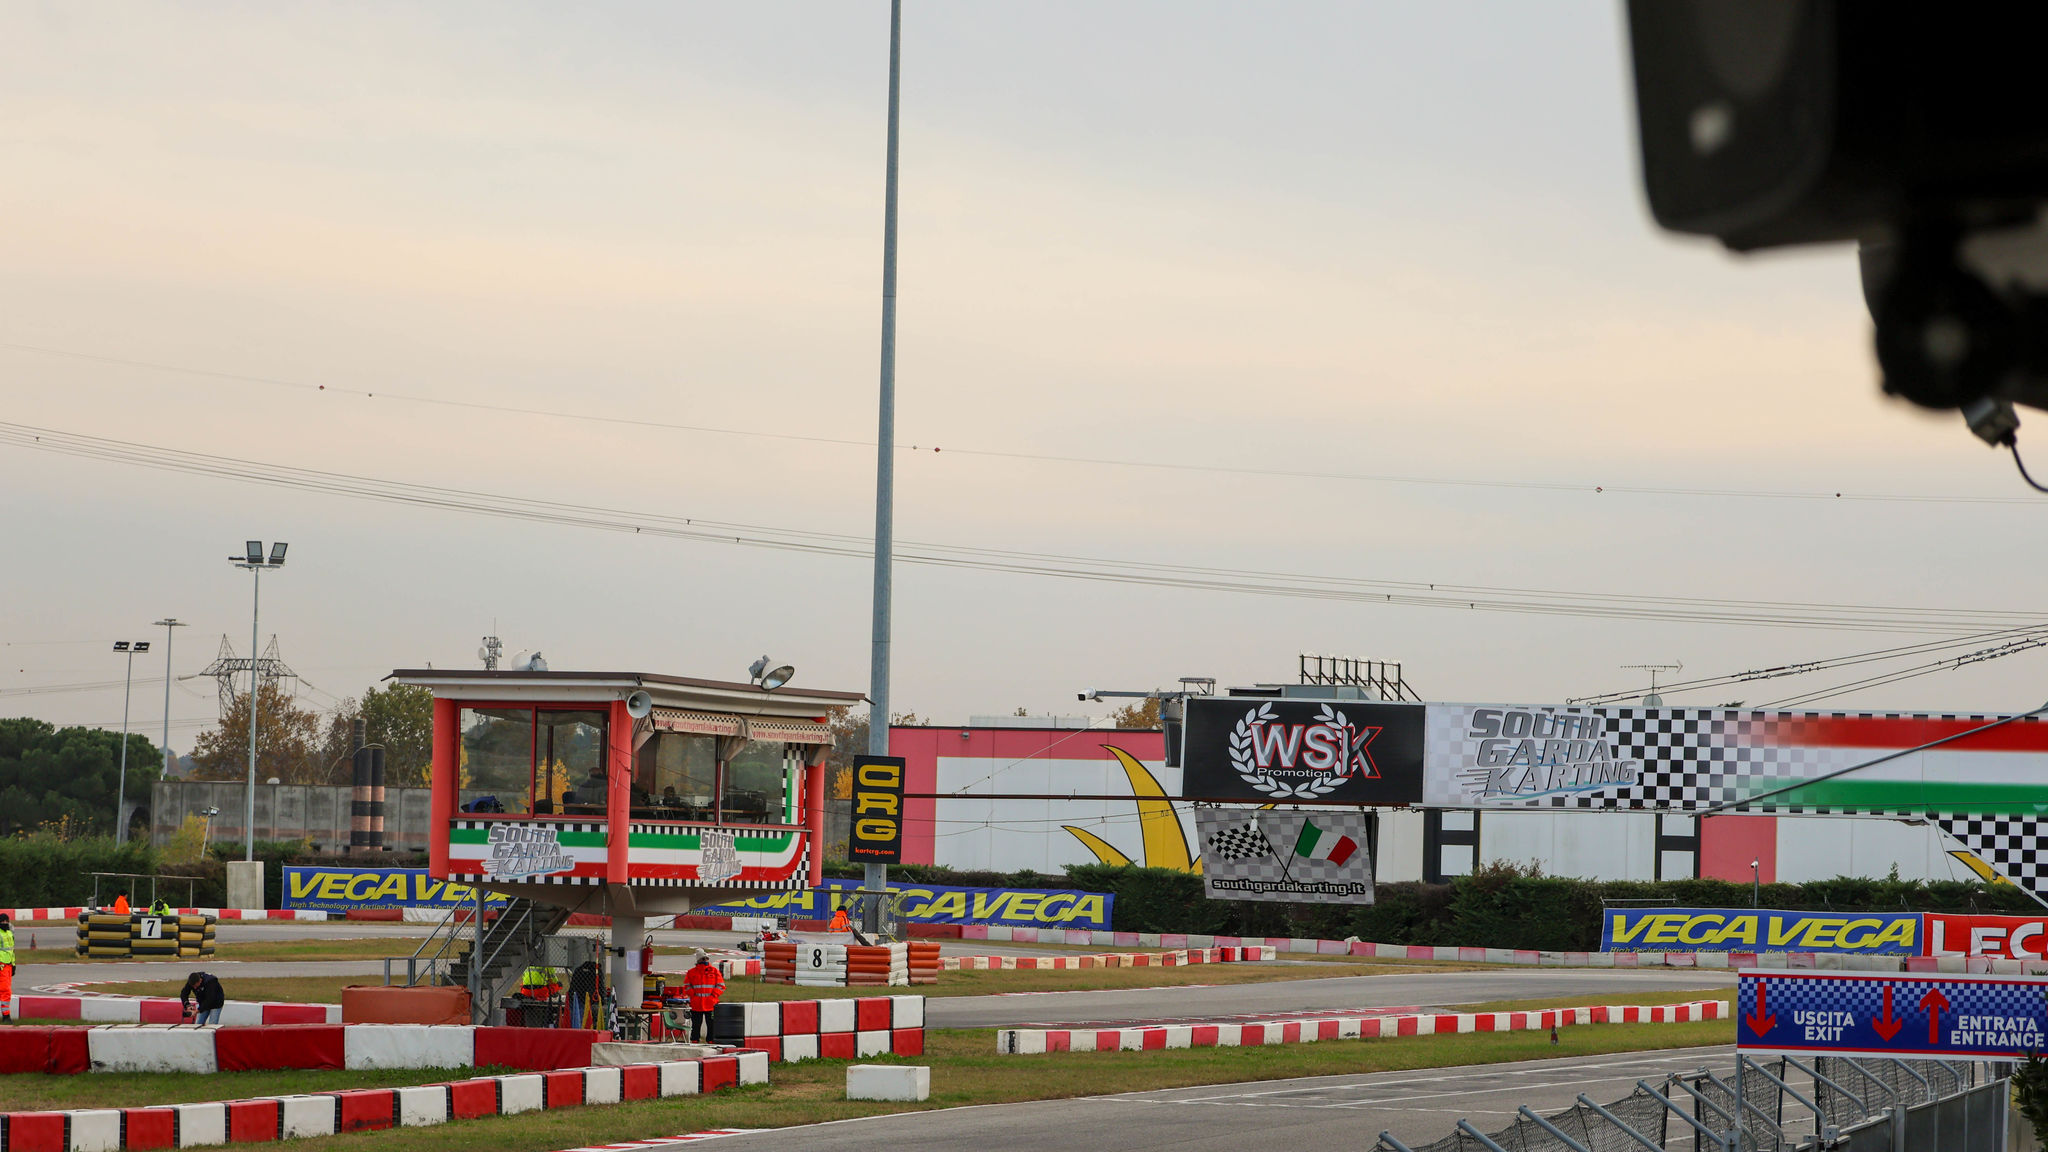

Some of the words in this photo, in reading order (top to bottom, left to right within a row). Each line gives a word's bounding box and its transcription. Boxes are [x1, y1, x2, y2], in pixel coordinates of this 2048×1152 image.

[1469, 709, 1601, 739] SOUTH
[1251, 723, 1383, 778] WSK
[1477, 739, 1611, 767] GARDA
[1257, 768, 1332, 778] Promotion
[1484, 760, 1637, 797] KARTING
[856, 764, 900, 841] CRG
[489, 826, 556, 843] SOUTH
[701, 832, 734, 848] SOUTH
[493, 842, 560, 859] GARDA
[703, 848, 736, 864] GARDA
[855, 847, 895, 855] kartcrg.com
[496, 855, 574, 876] KARTING
[290, 872, 407, 901] VEGA
[1212, 879, 1366, 895] southgardakarting.it
[309, 902, 349, 911] Technology
[972, 891, 1104, 924] VEGA
[146, 920, 156, 937] 7
[1612, 914, 1758, 945] VEGA
[1768, 916, 1917, 949] VEGA
[1932, 920, 2048, 960] LEC
[812, 949, 822, 968] 8
[1793, 1011, 1855, 1027] USCITA
[1958, 1015, 2038, 1033] ENTRATA
[1804, 1026, 1844, 1042] EXIT
[1951, 1030, 2045, 1048] ENTRANCE
